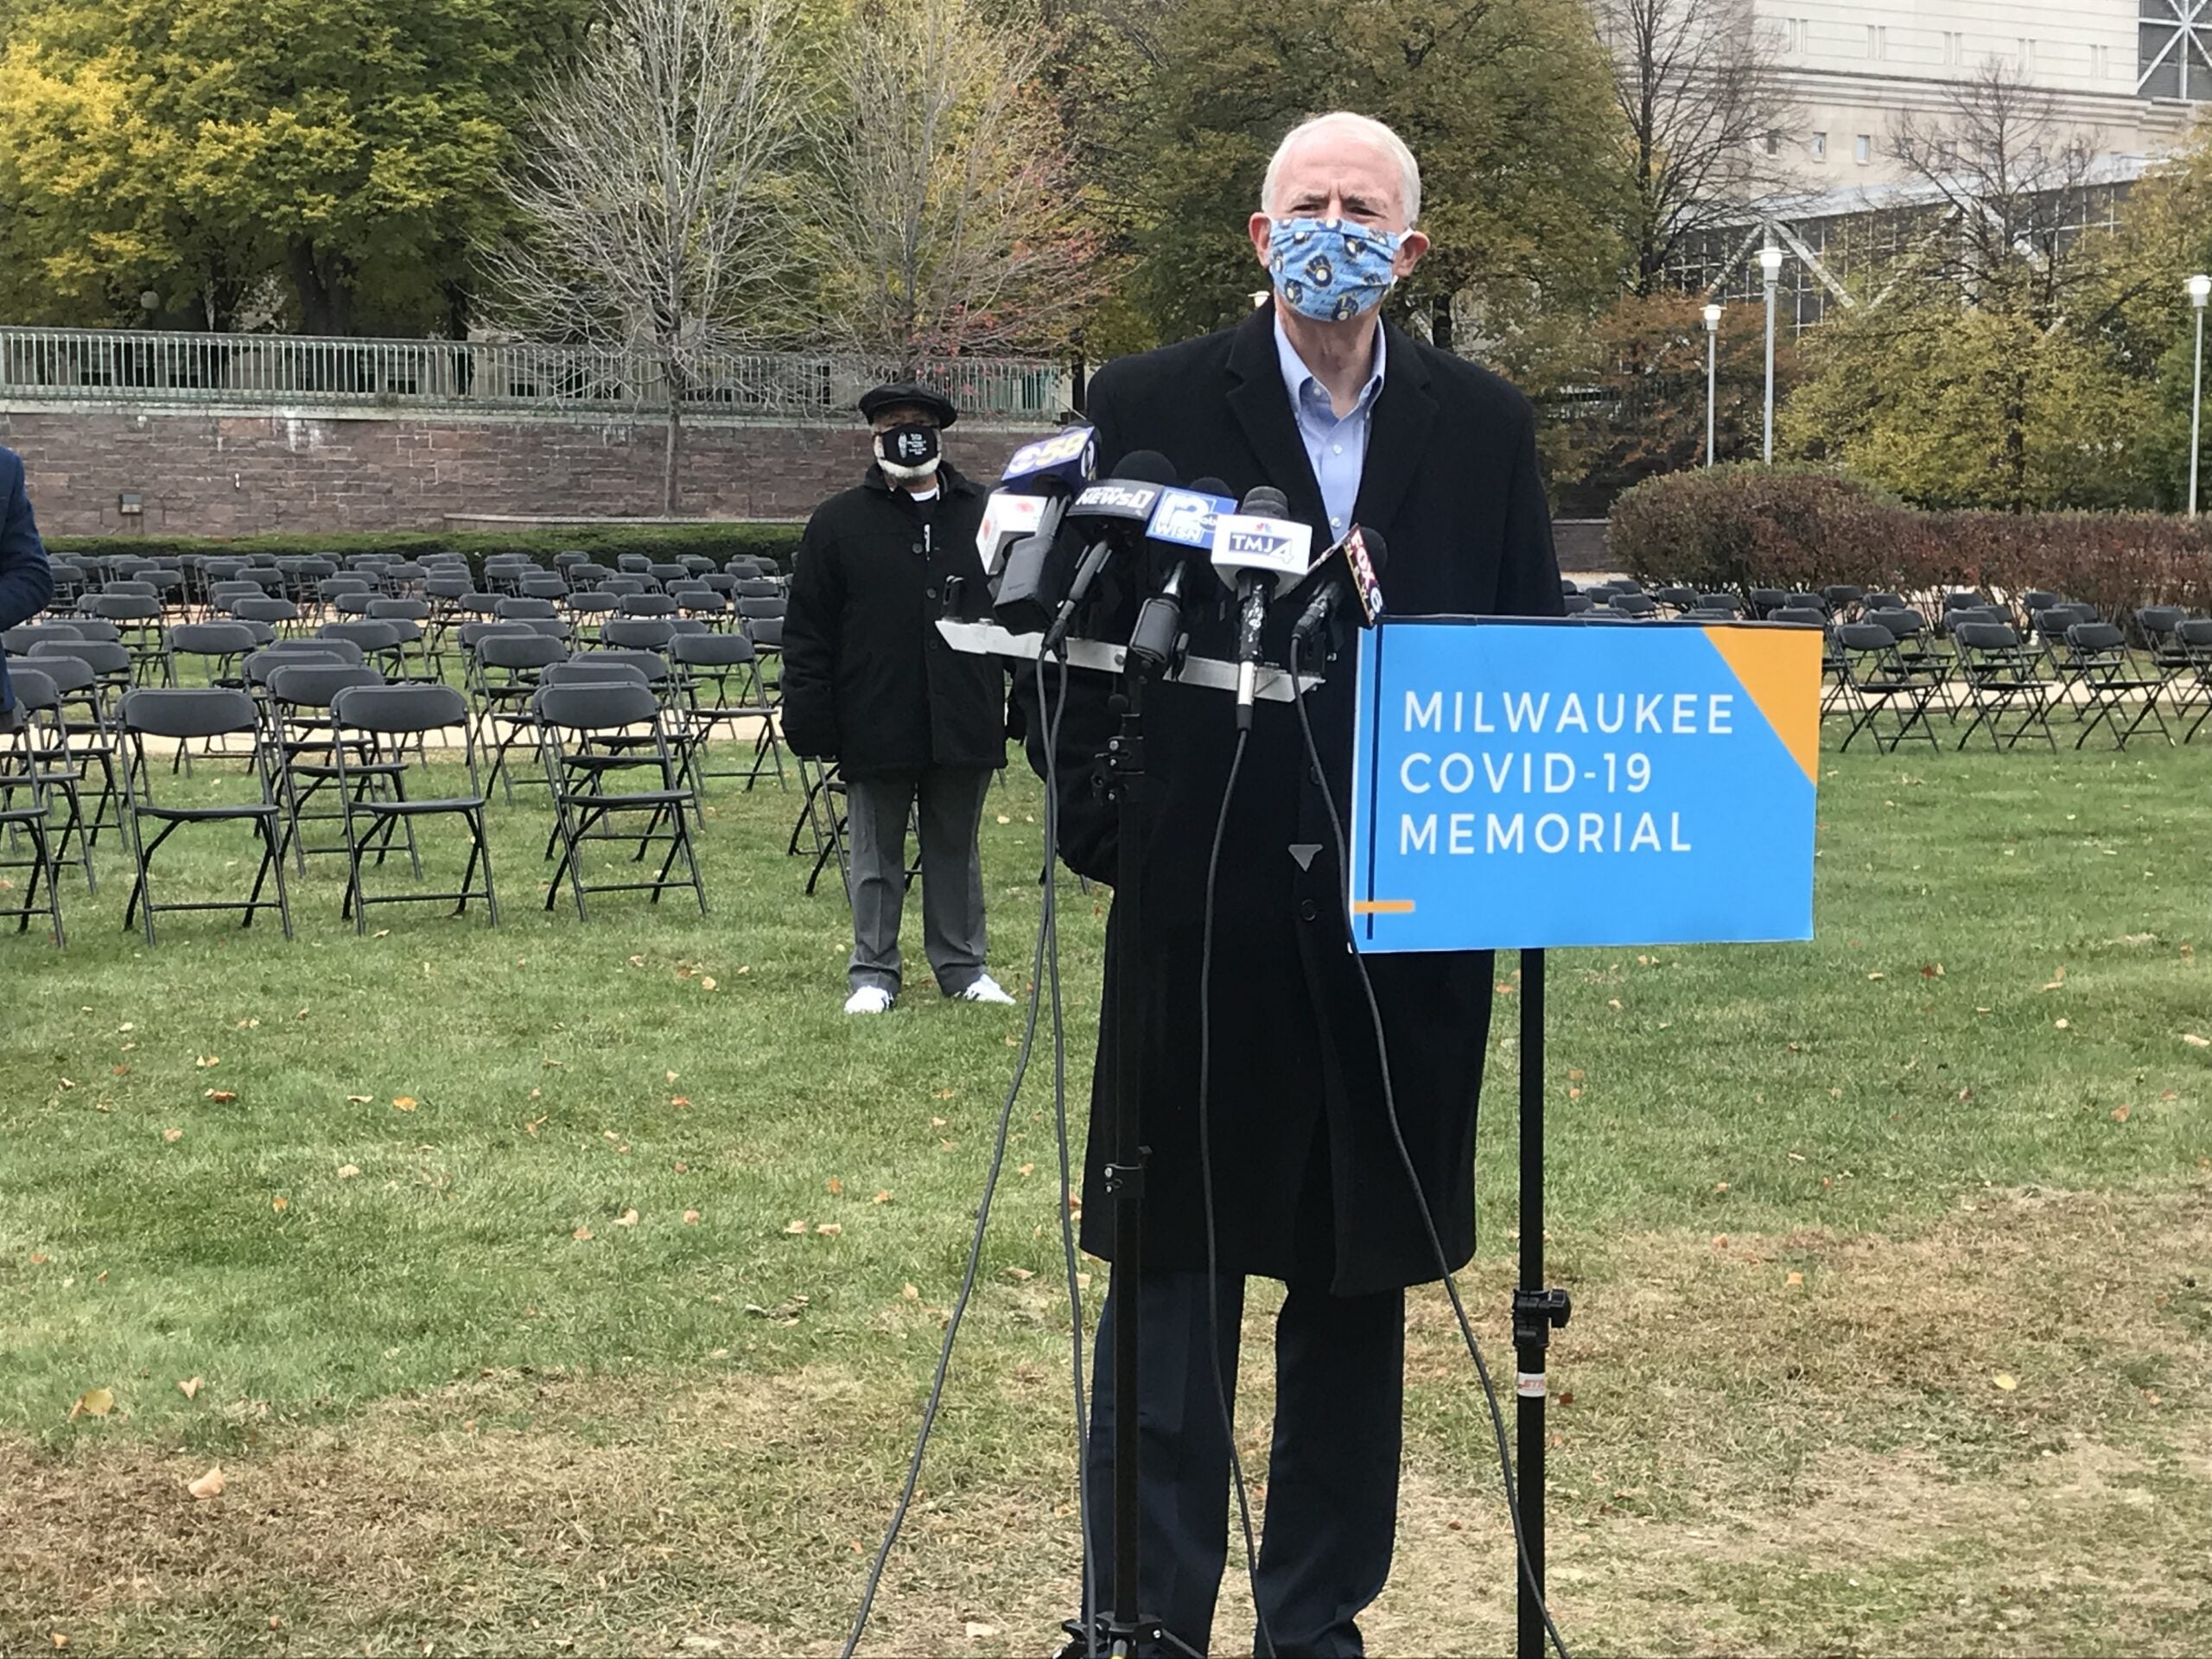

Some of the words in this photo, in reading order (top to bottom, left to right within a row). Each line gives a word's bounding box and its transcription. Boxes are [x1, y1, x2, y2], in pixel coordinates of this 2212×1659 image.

[1406, 691, 1732, 733] MILWAUKEE
[1402, 753, 1649, 792] COVID-19
[1402, 813, 1690, 854] MEMORIAL
